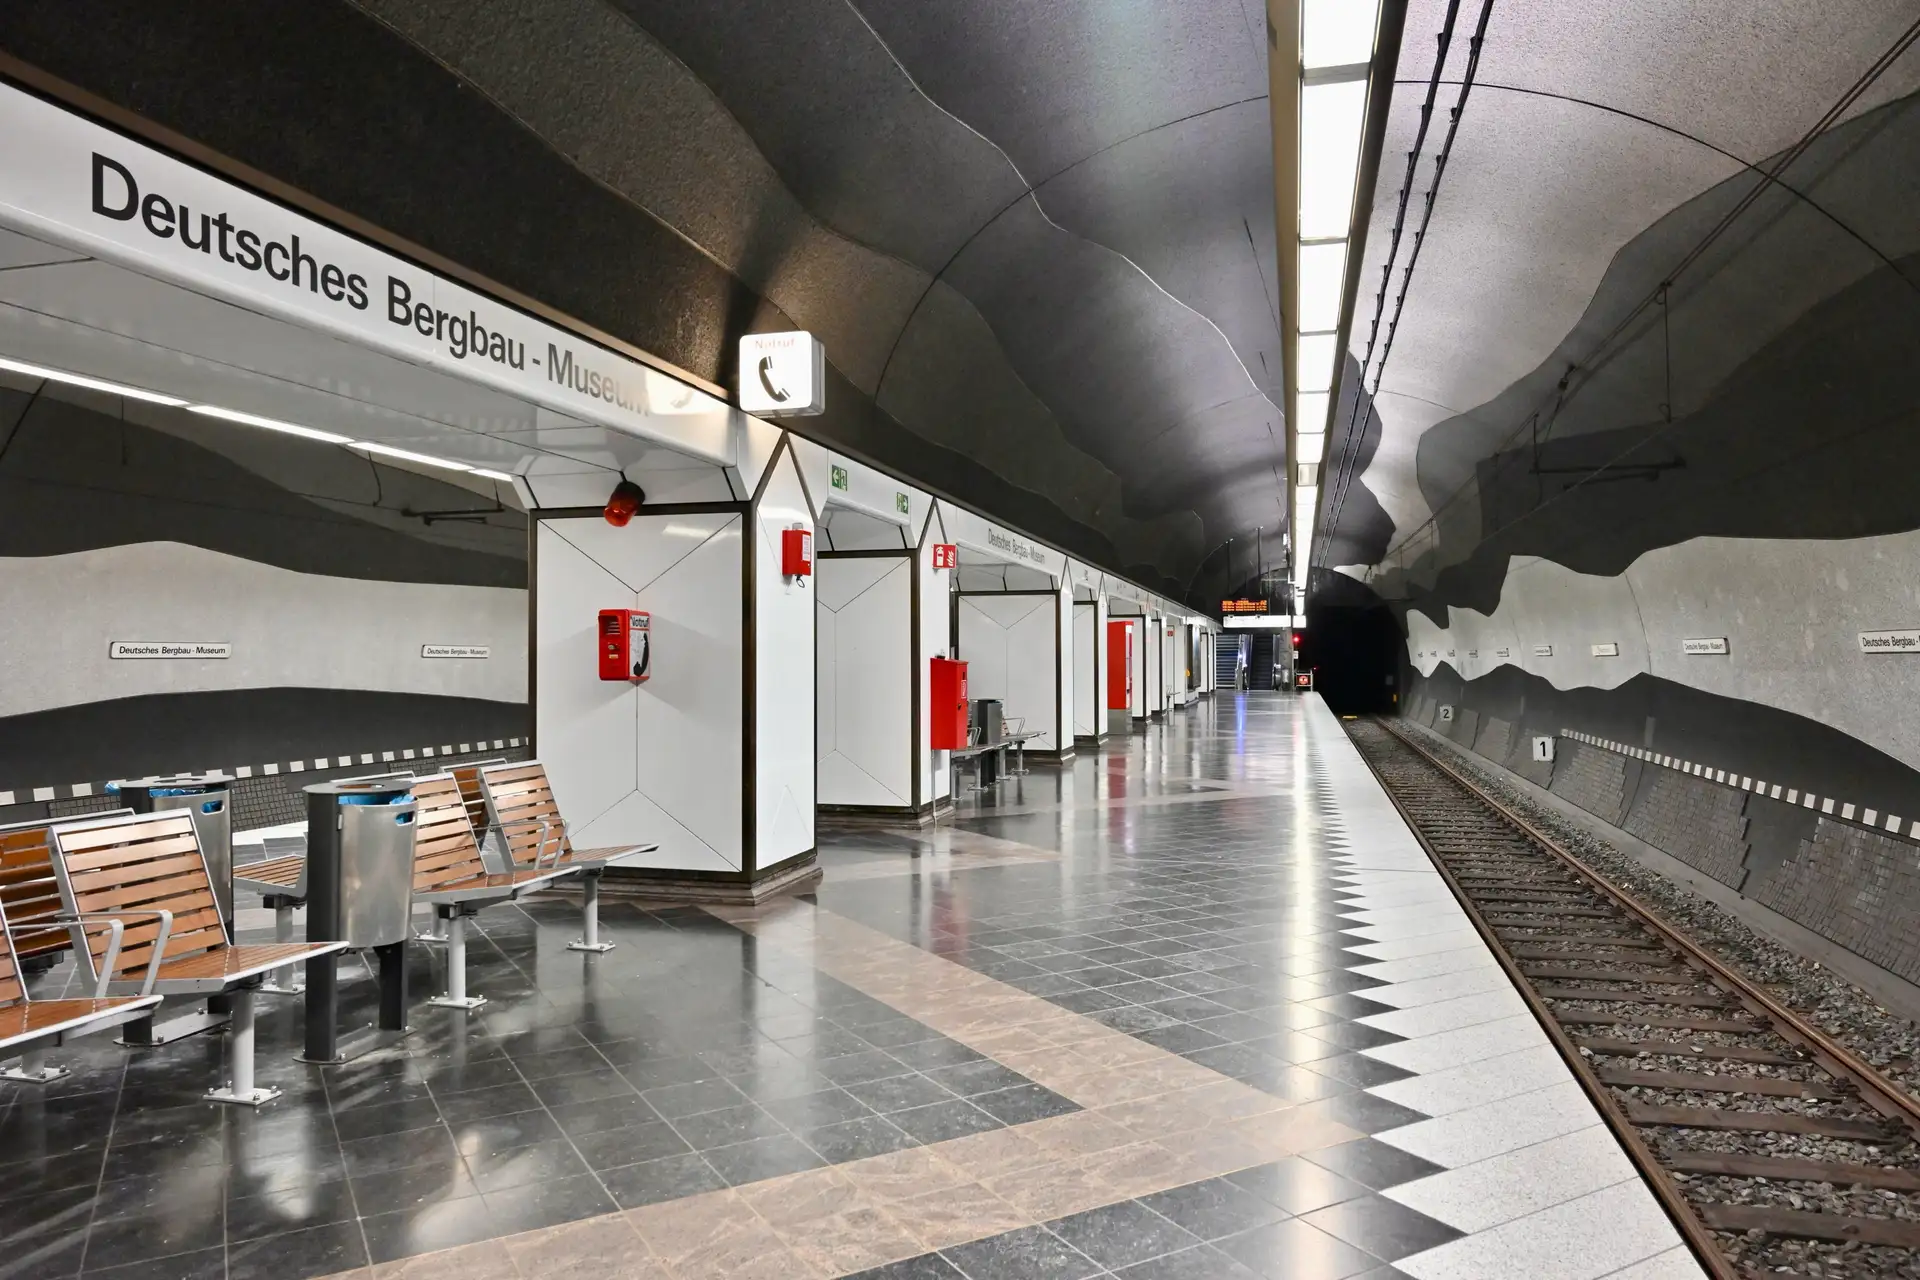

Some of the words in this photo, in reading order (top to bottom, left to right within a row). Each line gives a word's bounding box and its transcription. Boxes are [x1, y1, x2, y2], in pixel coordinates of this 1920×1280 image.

[91, 151, 369, 311] Deutsches
[387, 275, 525, 371] Bergbau
[1862, 636, 1891, 647] Deutsches
[1891, 636, 1916, 649] Bergbau
[119, 646, 158, 654] Deutsches
[161, 646, 191, 656] Bergbau
[195, 646, 226, 654] Museum
[1443, 708, 1450, 719] 2
[1540, 740, 1546, 757] 1
